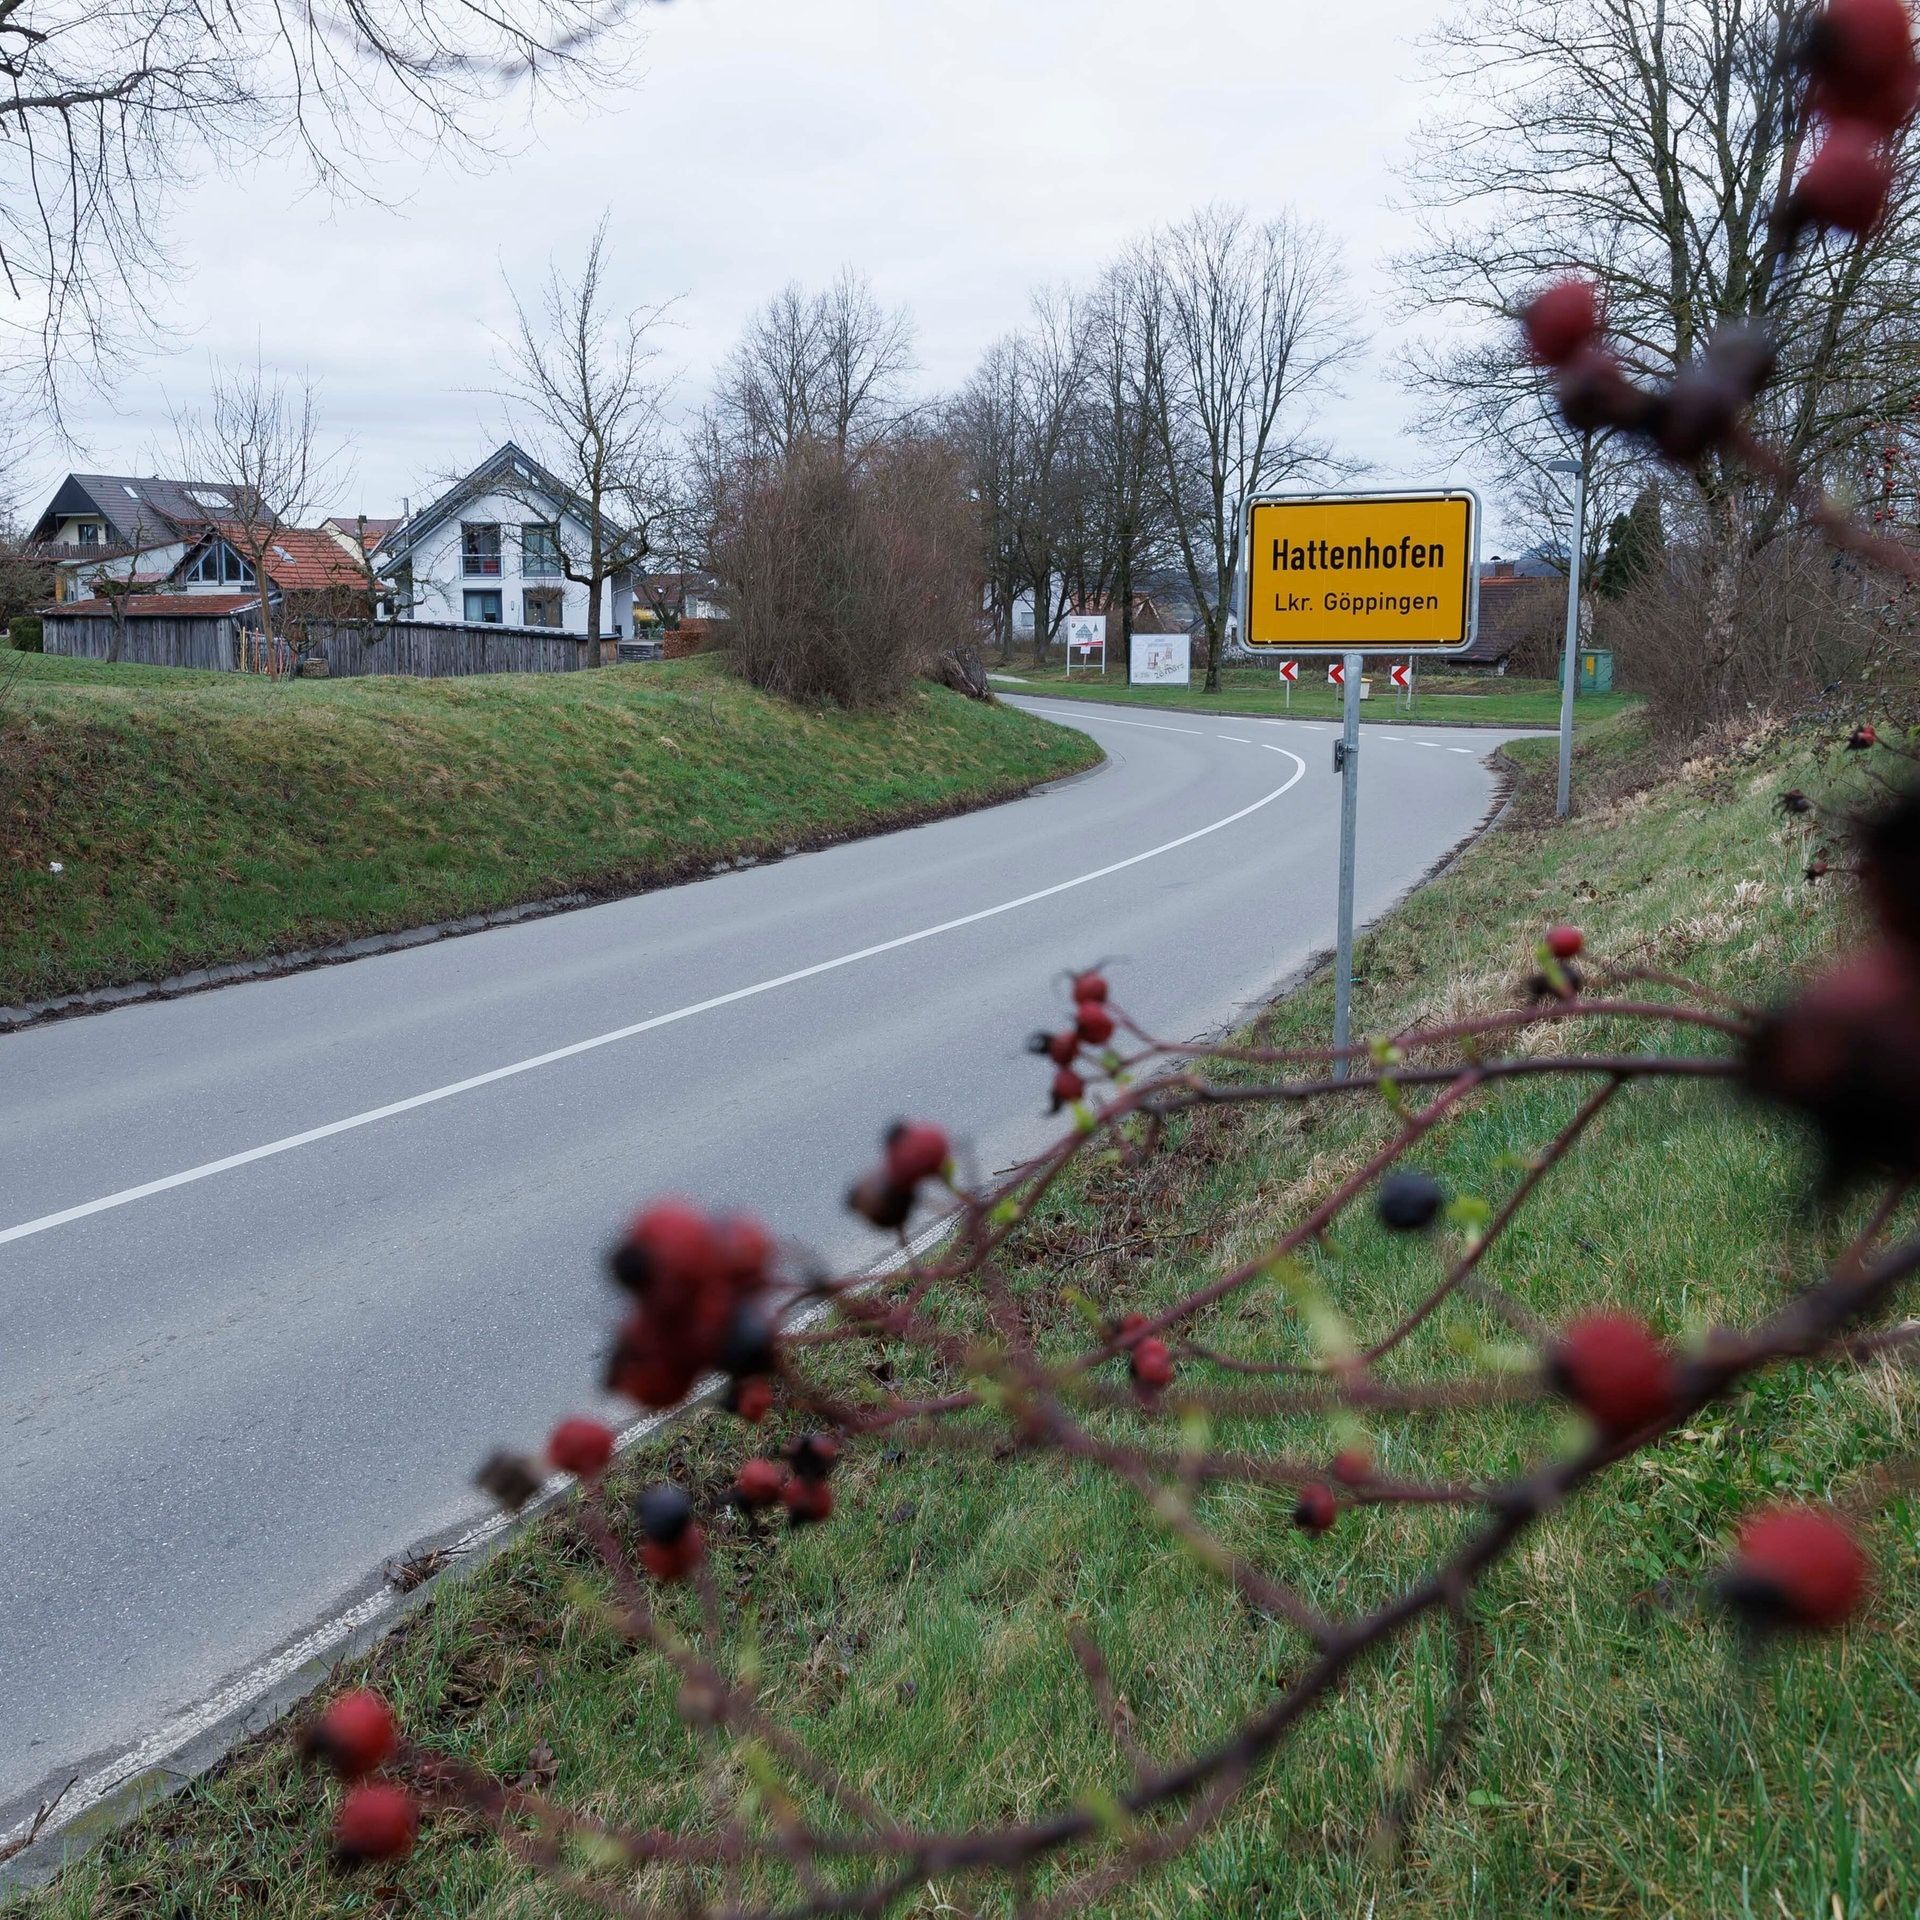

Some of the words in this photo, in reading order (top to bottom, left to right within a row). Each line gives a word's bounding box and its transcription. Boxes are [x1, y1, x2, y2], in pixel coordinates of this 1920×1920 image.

[1272, 536, 1444, 571] Hattenhofen
[1275, 593, 1313, 611] Lkr.
[1324, 592, 1438, 615] Göppingen
